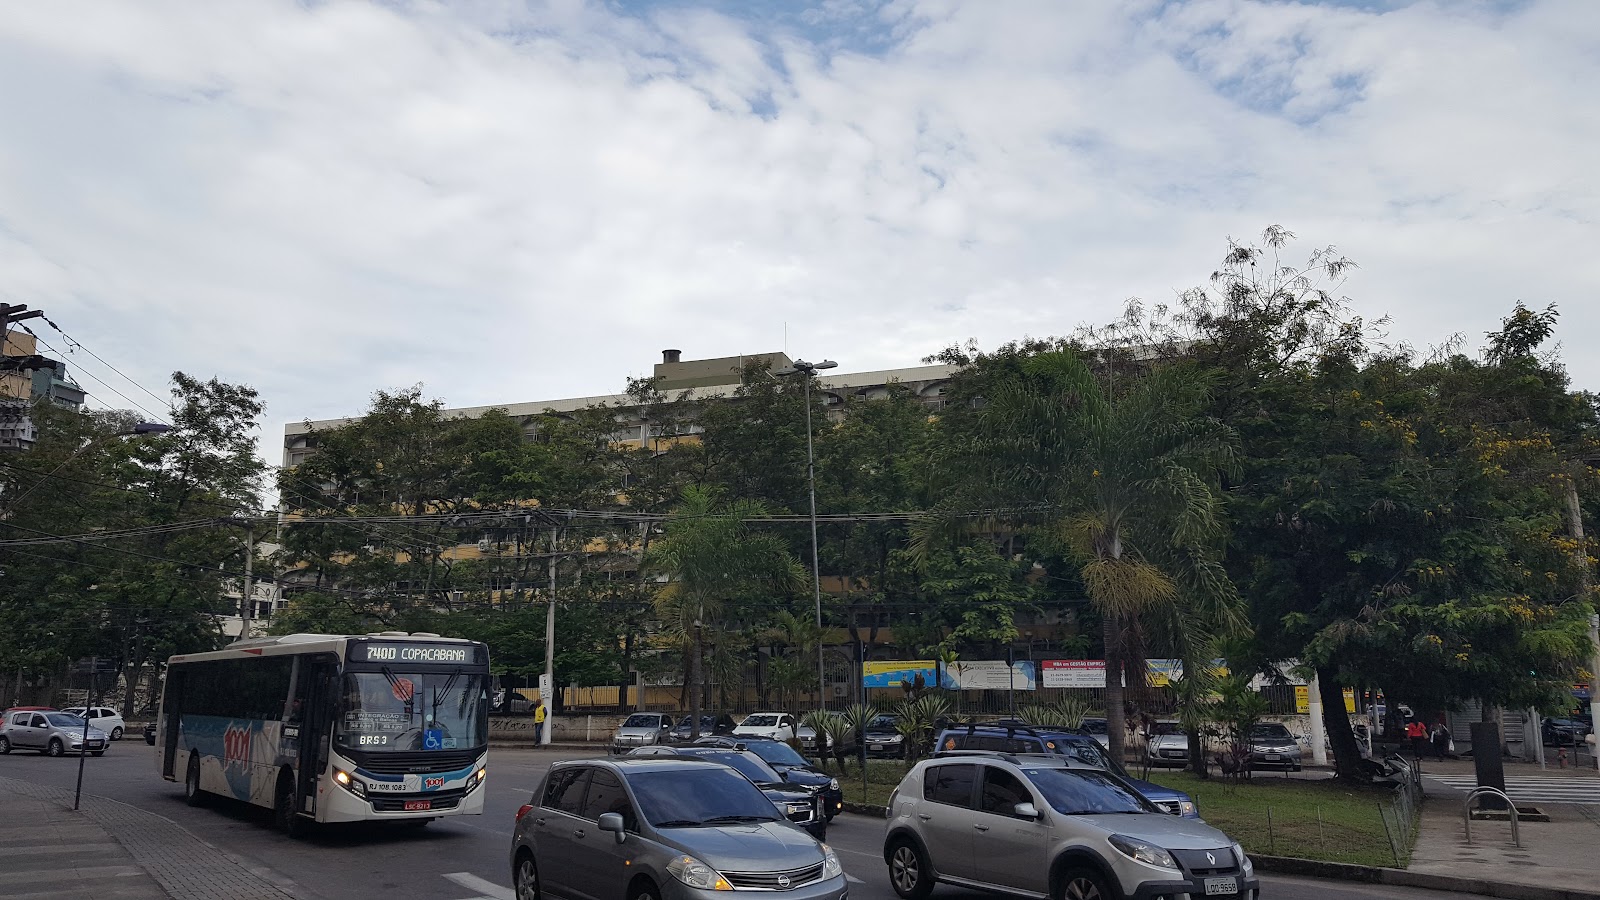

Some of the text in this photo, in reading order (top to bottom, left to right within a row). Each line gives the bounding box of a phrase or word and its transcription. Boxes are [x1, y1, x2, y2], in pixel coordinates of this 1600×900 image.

[366, 646, 466, 661] 740D COPACABANA
[360, 735, 387, 745] BRS 3
[224, 721, 252, 775] 1001
[425, 775, 444, 789] 1001
